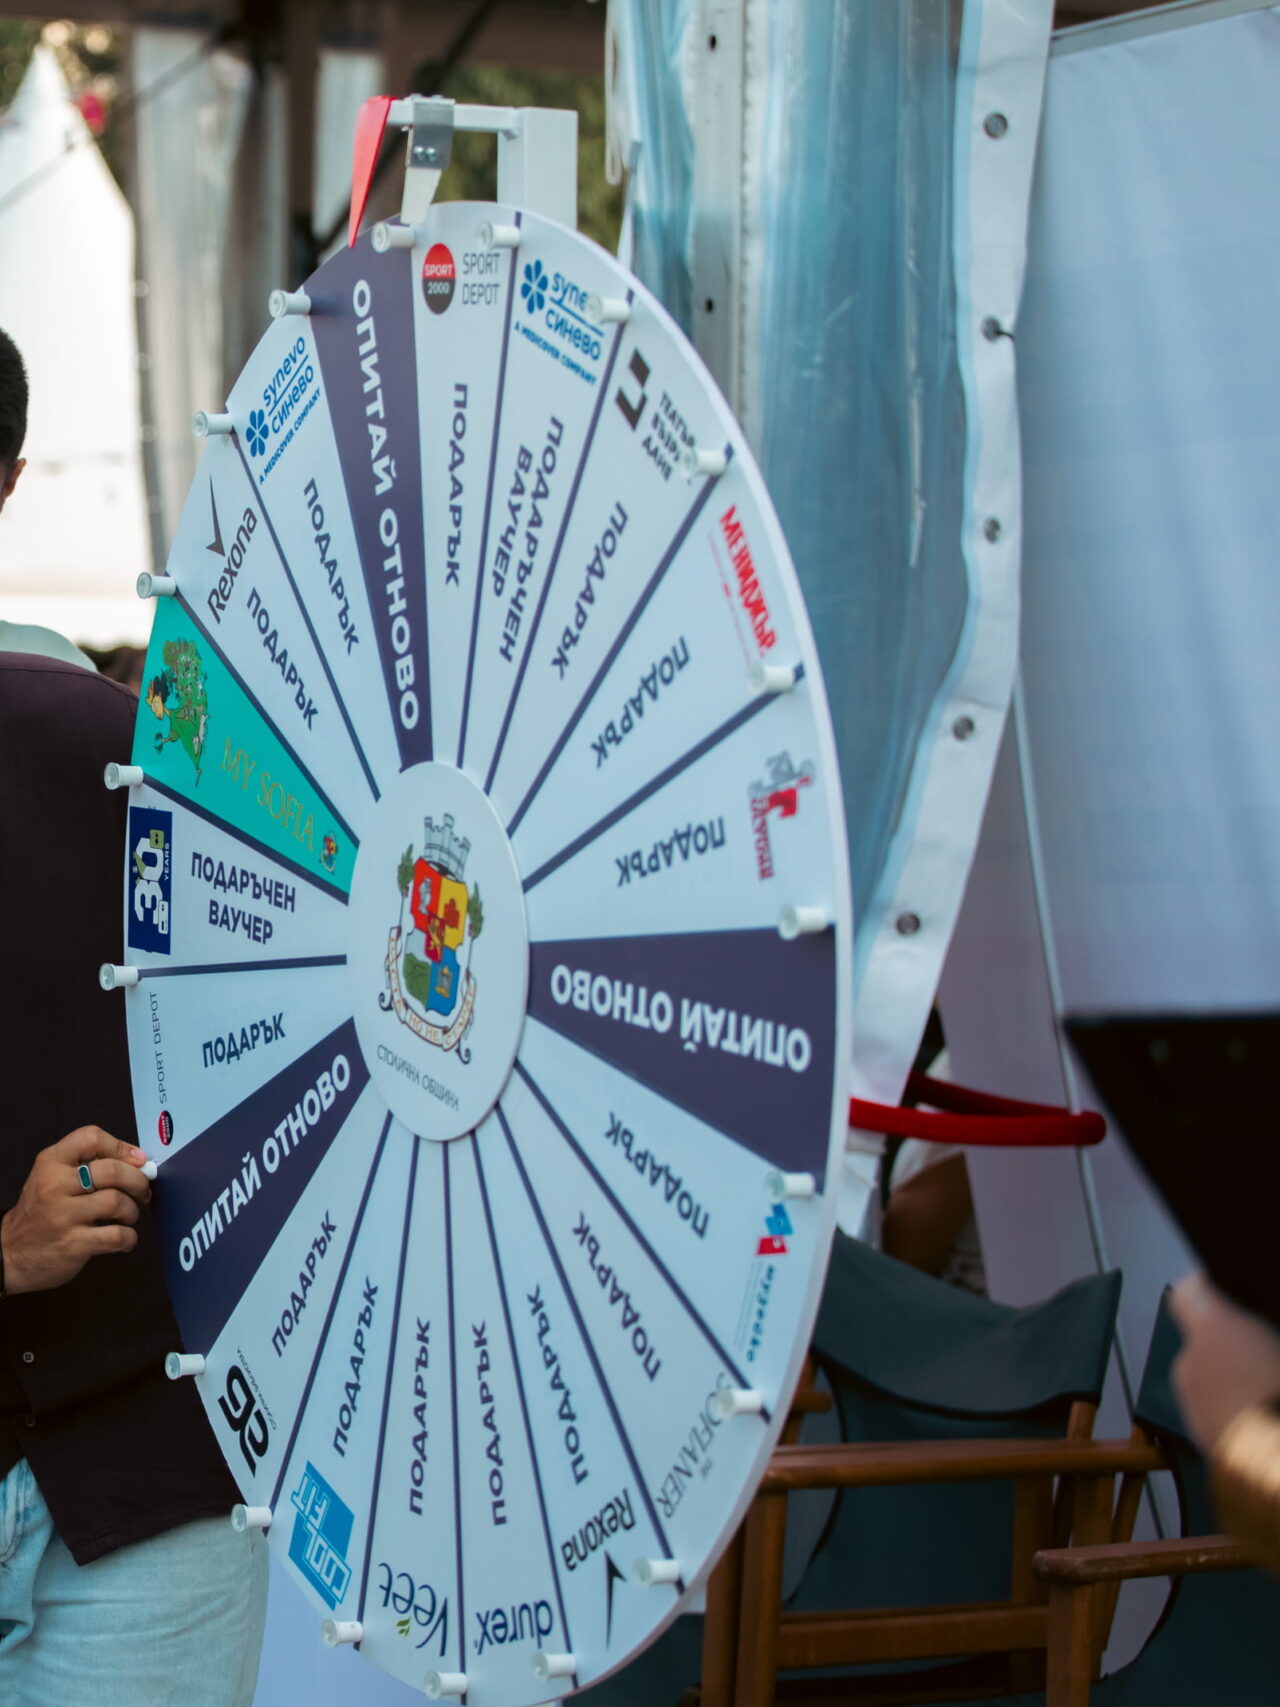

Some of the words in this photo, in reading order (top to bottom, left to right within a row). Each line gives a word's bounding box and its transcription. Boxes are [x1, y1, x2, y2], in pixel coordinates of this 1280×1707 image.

[424, 263, 453, 277] SPORT
[427, 281, 450, 294] 2000
[462, 283, 500, 305] DEPOT
[463, 252, 500, 275] SPORT
[552, 272, 588, 312] syne
[263, 336, 305, 407] synevo
[264, 428, 295, 477] MEDICOVER
[294, 386, 321, 431] COMPANY
[650, 415, 682, 464] ВЪЗР
[352, 279, 397, 496] ОПИТАЙ
[378, 507, 420, 730] ОТНОВО
[445, 383, 468, 586] ПОДАРЪК
[493, 445, 534, 597] ВАУЧЕР
[207, 506, 258, 624] Rexona
[303, 477, 360, 657] ПОДАРЪК
[499, 415, 564, 663] ПОДАРЪЧЕН
[550, 501, 629, 679] ПОДАРЪК
[246, 588, 320, 731] ПОДАРЪК
[589, 635, 690, 768] ПОДАРЪК
[221, 736, 256, 790] MY
[257, 771, 315, 852] SOFIA
[191, 851, 296, 914] ПОДАРЪЧЕН
[615, 816, 726, 887] ПОДАРЪК
[208, 899, 273, 946] ВАУЧЕР
[149, 992, 162, 1045] DEPOT
[201, 1012, 286, 1068] ПОДАРЪК
[550, 963, 674, 1034] ОТНОВО
[679, 998, 812, 1073] ОПИТАЙ
[155, 1051, 167, 1105] SPORT
[377, 1044, 420, 1086] СТОЛИЧНА
[178, 1150, 262, 1272] ОПИТАЙ
[262, 1054, 351, 1174] ОТНОВО
[605, 1111, 710, 1239] ПОДАРЪК
[271, 1209, 337, 1358] ПОДАРЪК
[573, 1211, 661, 1382] ПОДАРЪК
[332, 1274, 379, 1458] ПОДАРЪК
[527, 1283, 589, 1485] ПОДАРЪК
[409, 1316, 431, 1516] ПОДАРЪК
[472, 1320, 507, 1526] ПОДАРЪК
[293, 1472, 330, 1528] FIT
[561, 1488, 637, 1572] Rexona
[303, 1522, 352, 1597] COOL
[378, 1562, 448, 1657] Veet
[476, 1599, 553, 1655] durex
